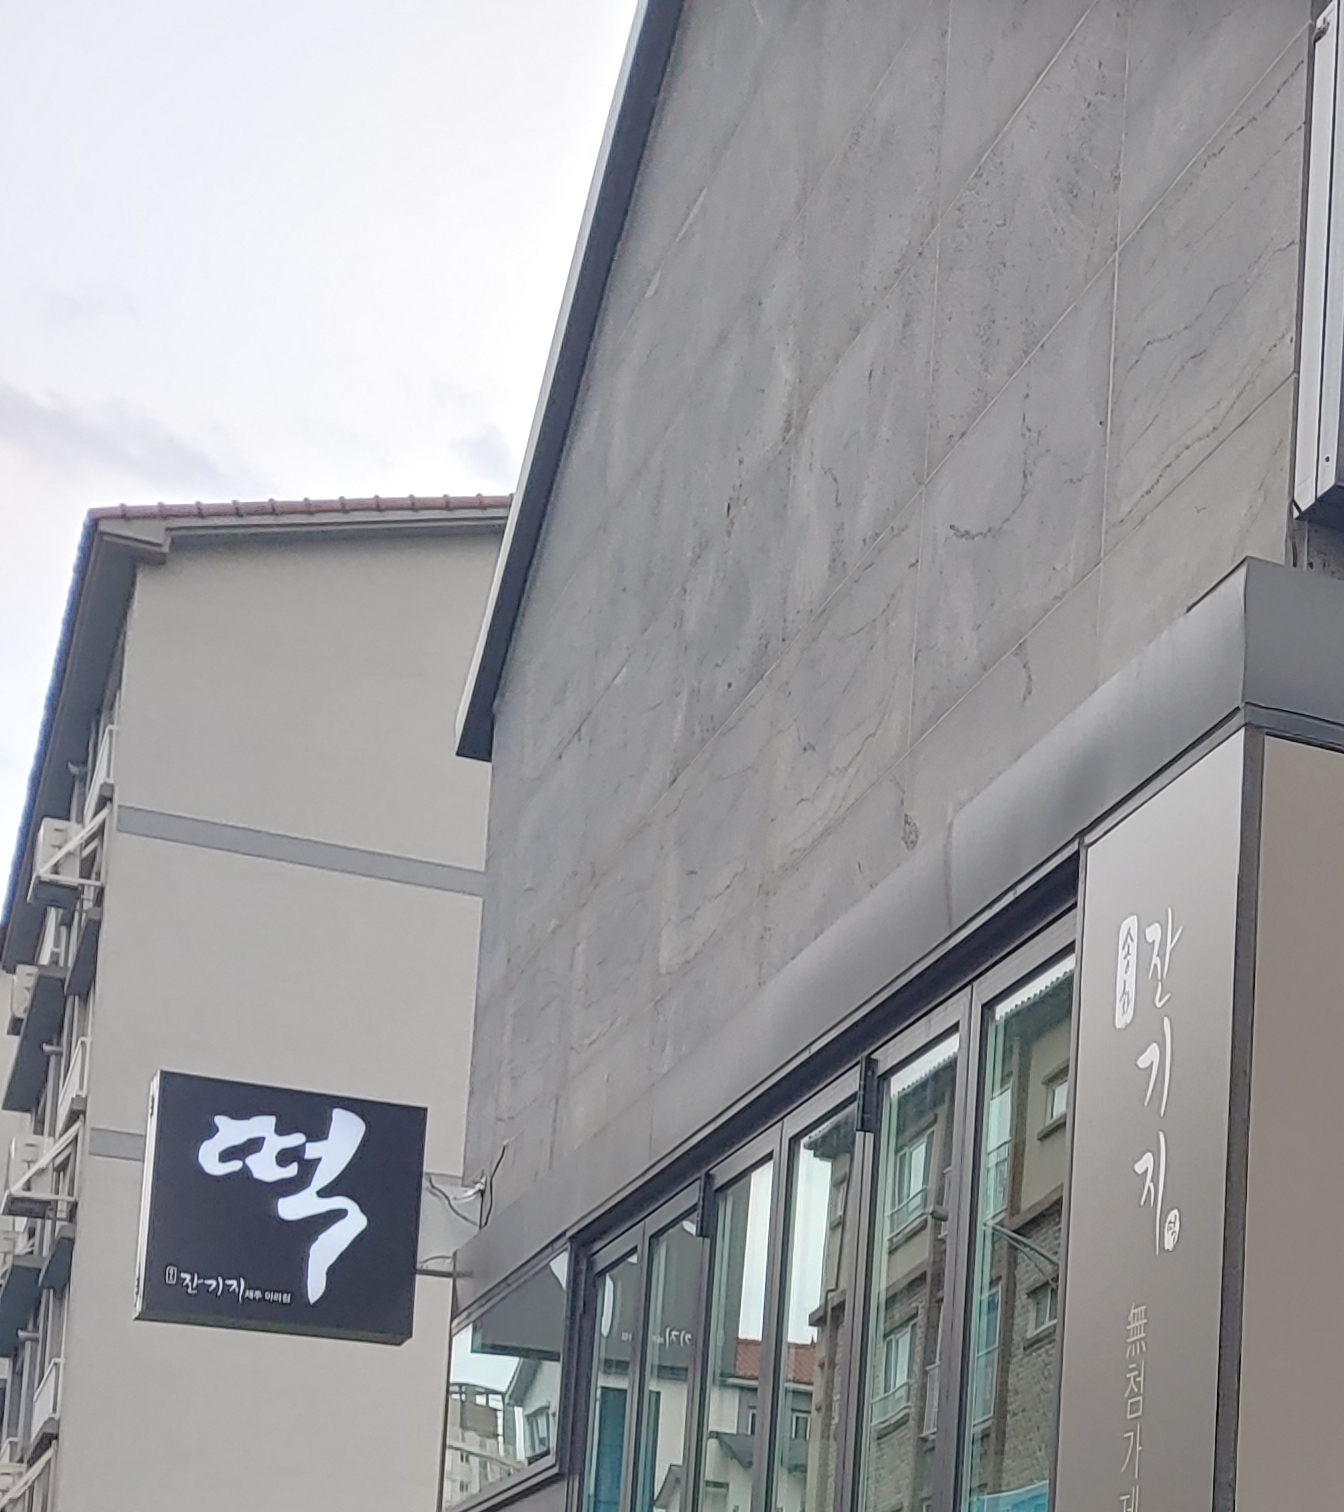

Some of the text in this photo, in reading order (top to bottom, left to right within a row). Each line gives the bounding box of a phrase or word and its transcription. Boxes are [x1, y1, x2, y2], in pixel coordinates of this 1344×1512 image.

[1134, 907, 1183, 1257] 잔기지
[180, 1272, 245, 1304] 잔기지
[198, 1107, 368, 1305] 떡
